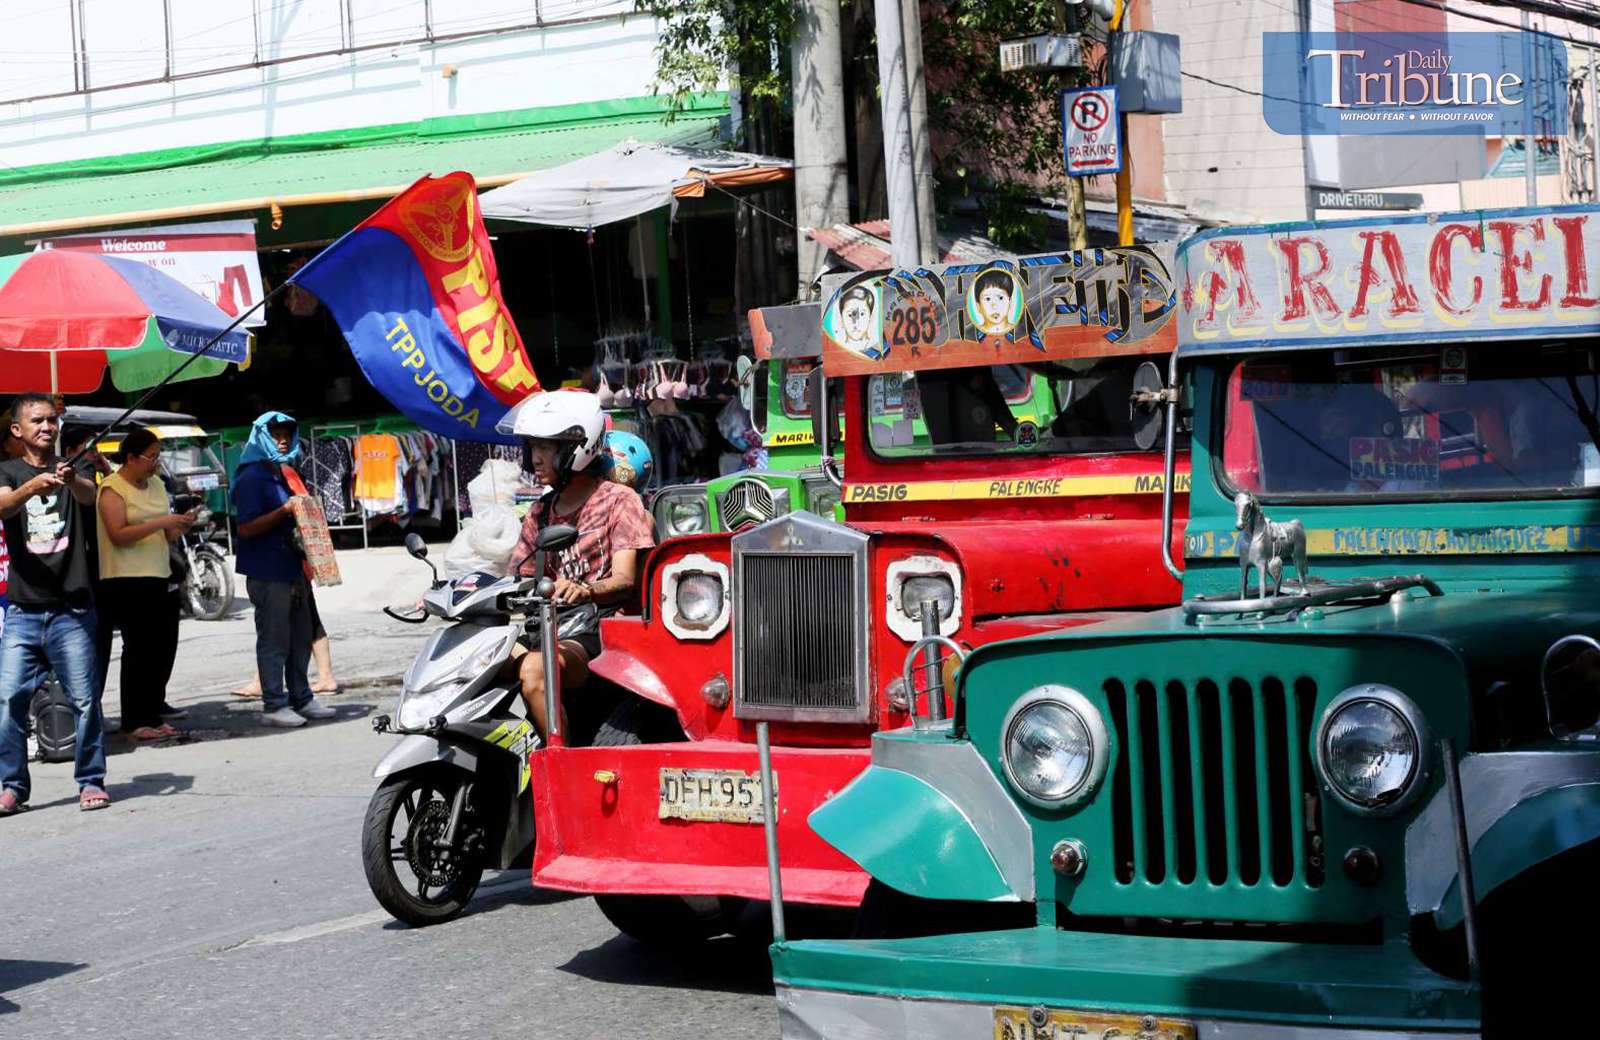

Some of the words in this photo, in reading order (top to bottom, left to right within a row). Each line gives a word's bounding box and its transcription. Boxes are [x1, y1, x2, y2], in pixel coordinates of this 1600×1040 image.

[1083, 132, 1098, 143] NO
[1069, 143, 1116, 157] PARKING
[101, 239, 167, 252] Welcome
[892, 306, 936, 346] 285
[851, 485, 908, 501] PASIG
[989, 478, 1063, 497] PALENGKE
